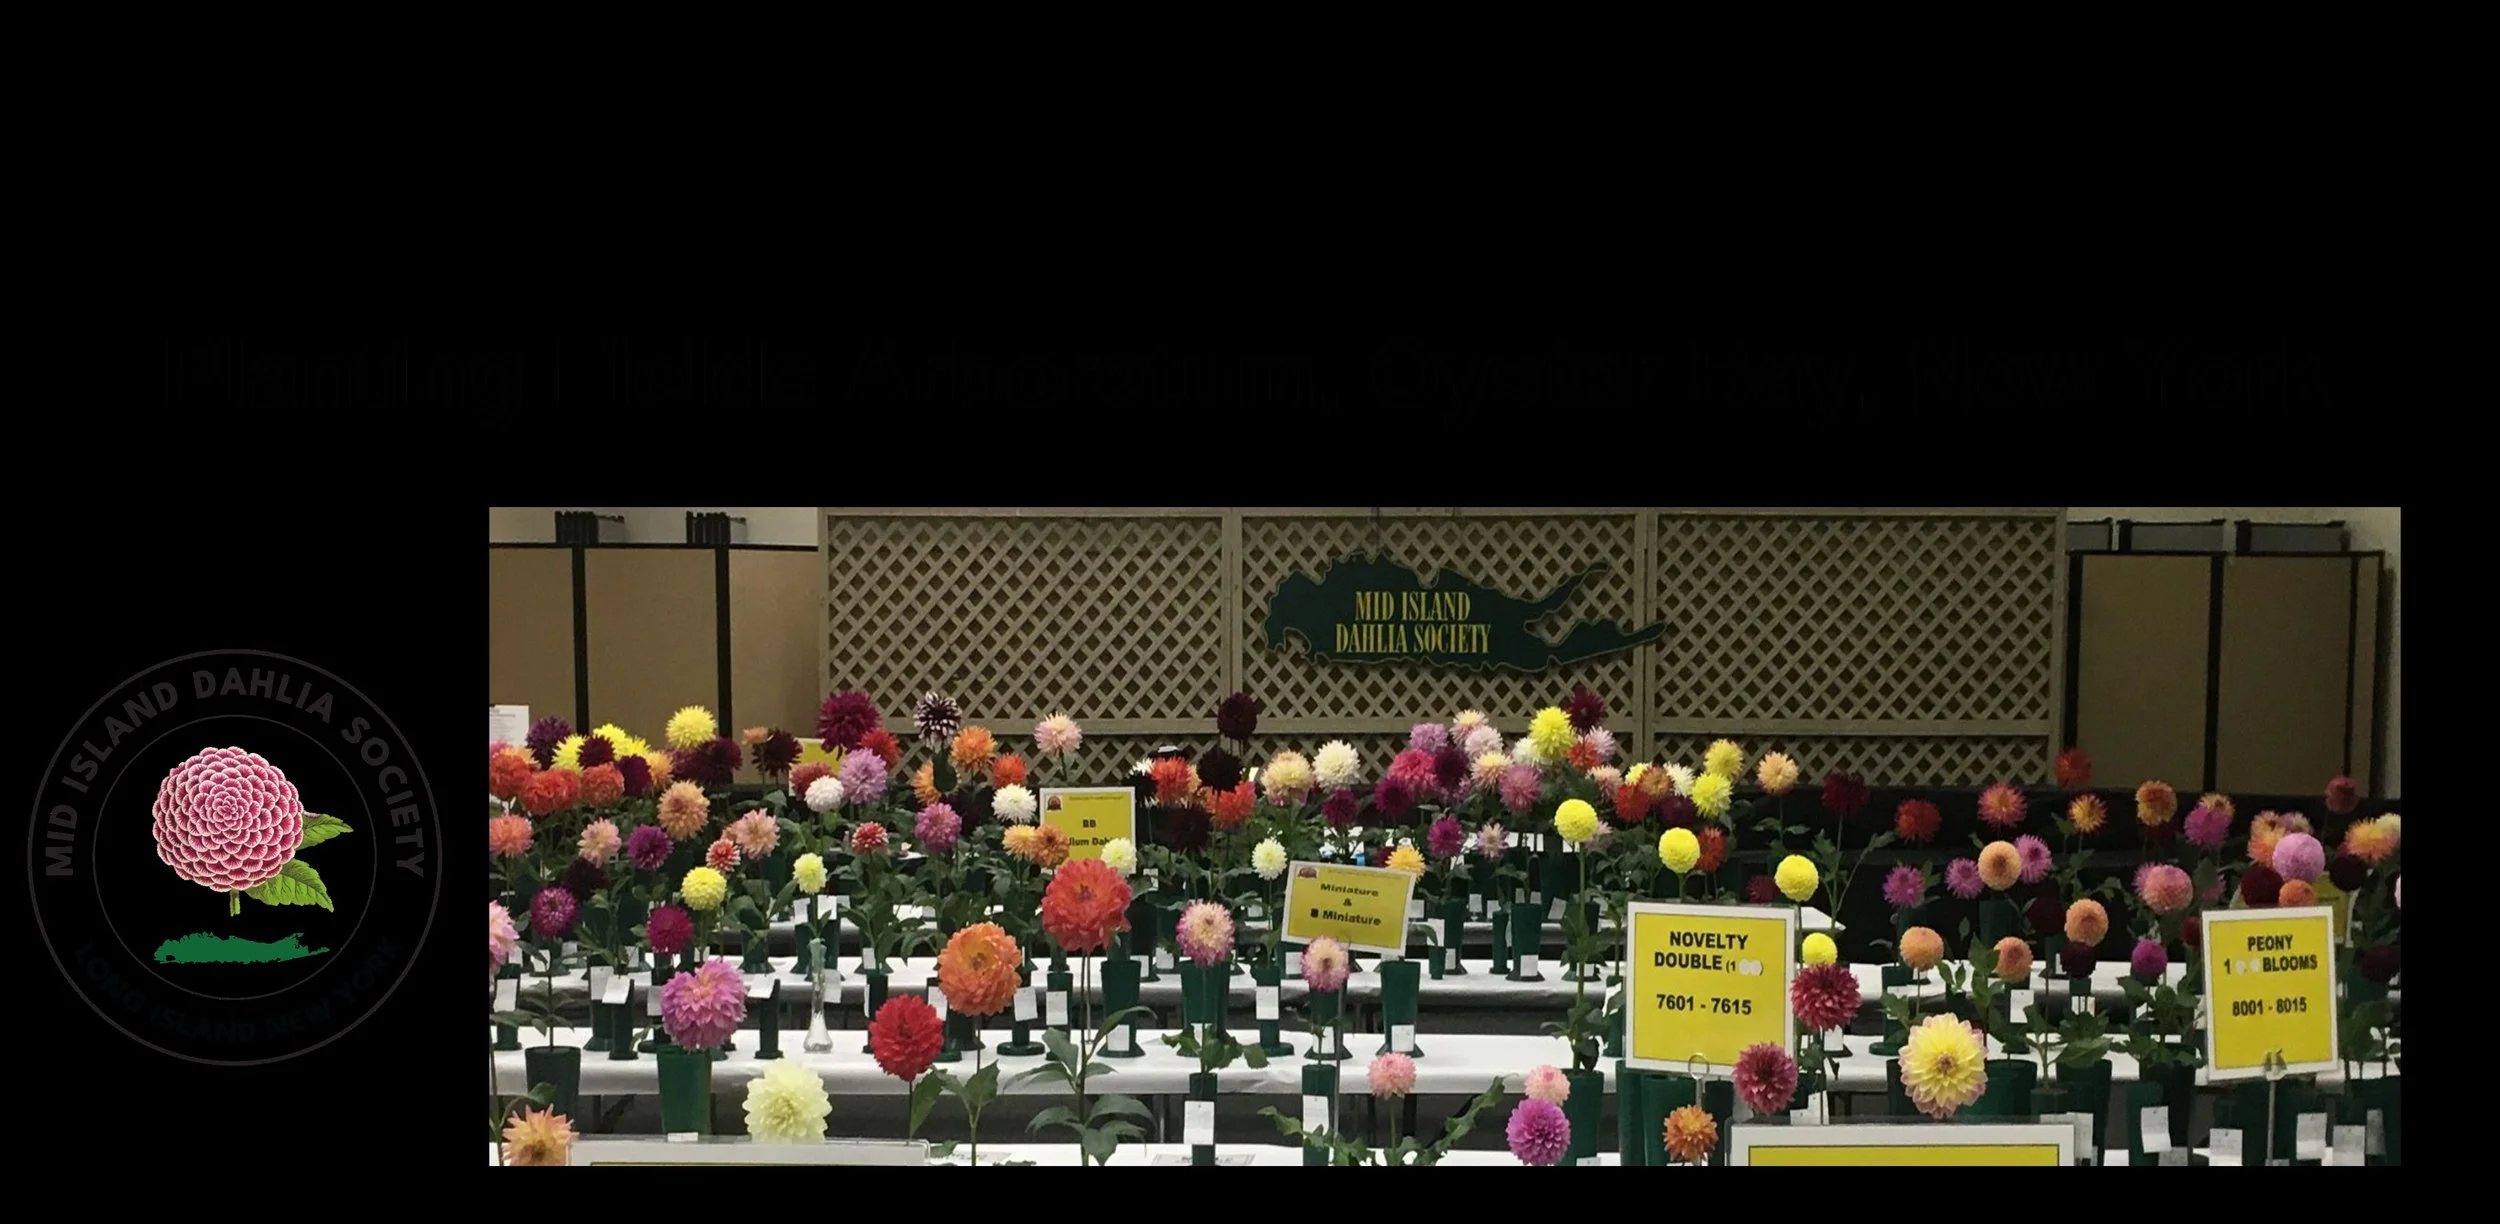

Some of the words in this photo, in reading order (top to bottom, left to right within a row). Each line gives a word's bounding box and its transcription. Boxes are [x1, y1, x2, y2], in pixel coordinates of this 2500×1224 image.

[1355, 591, 1394, 621] MID
[1402, 591, 1470, 621] ISLAND
[1335, 623, 1406, 653] DAHLIA
[1413, 623, 1491, 654] SOCIETY
[1320, 883, 1379, 897] Miniature
[1343, 898, 1352, 907] &
[1322, 910, 1382, 926] Miniature
[1669, 931, 1748, 950] NOVELTY
[2247, 935, 2293, 951] PEONY
[1654, 951, 1722, 971] DOUBLE
[2263, 954, 2318, 972] BLOOMS
[1656, 993, 1694, 1011] 7601
[1711, 997, 1752, 1015] 7615
[2232, 999, 2263, 1017] 8001
[2276, 997, 2307, 1014] 8015
